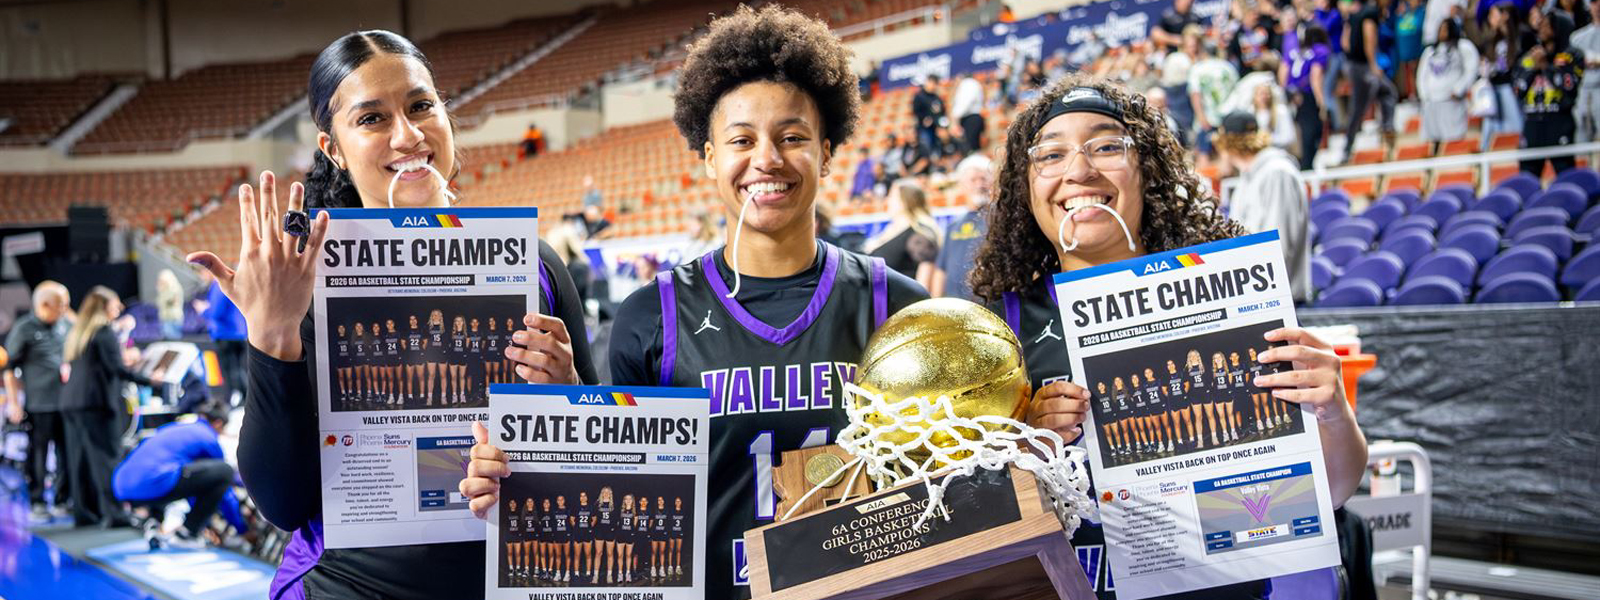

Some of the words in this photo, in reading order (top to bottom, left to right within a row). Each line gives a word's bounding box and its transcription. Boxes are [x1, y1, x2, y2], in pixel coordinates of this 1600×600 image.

[402, 216, 429, 226] AIA
[324, 239, 405, 267] STATE
[411, 237, 526, 266] CHAMPS!
[1143, 260, 1171, 274] AIA
[330, 278, 347, 286] 2026
[348, 277, 358, 286] 6A
[359, 276, 400, 286] BASKETBALL
[400, 276, 421, 285] STATE
[421, 275, 471, 285] CHAMPIONSHIP
[1072, 287, 1153, 328] STATE
[1156, 262, 1277, 310] CHAMPS!
[1238, 304, 1259, 313] MARCH
[1266, 300, 1281, 308] 2026
[1083, 335, 1100, 346] 2026
[1110, 325, 1151, 340] BASKETBALL
[1151, 320, 1172, 333] STATE
[1172, 310, 1222, 329] CHAMPIONSHIP
[387, 342, 397, 350] 24
[410, 338, 420, 346] 22
[455, 339, 463, 347] 13
[1194, 375, 1202, 383] 15
[1217, 376, 1225, 384] 13
[1235, 375, 1243, 383] 14
[701, 361, 859, 418] VALLEY
[1171, 383, 1180, 391] 22
[578, 394, 605, 404] AIA
[1149, 391, 1158, 399] 24
[363, 416, 389, 425] VALLEY
[390, 415, 411, 424] VISTA
[412, 415, 431, 423] BACK
[432, 414, 443, 423] ON
[444, 414, 458, 422] TOP
[459, 413, 477, 422] ONCE
[500, 413, 579, 443] STATE
[586, 415, 699, 446] CHAMPS!
[384, 438, 412, 446] Mercury
[507, 452, 522, 461] 026
[522, 452, 532, 461] 6A
[532, 453, 572, 462] BASKETBALL
[572, 453, 592, 462] STATE
[593, 454, 642, 463] CHAMPIONSHIP
[1135, 464, 1162, 477] VALLEY
[1163, 460, 1184, 472] VISTA
[1185, 457, 1205, 469] BACK
[1205, 455, 1216, 465] ON
[1217, 452, 1232, 463] TOP
[1232, 449, 1253, 460] ONCE
[1253, 445, 1277, 456] AGAIN
[748, 427, 831, 520] 1
[1159, 481, 1176, 489] Suns
[1160, 485, 1188, 494] Mercury
[866, 500, 887, 511] AIA
[580, 515, 588, 523] 22
[602, 511, 610, 520] 15
[832, 523, 848, 536] 6A
[850, 498, 931, 532] CONFERENC
[527, 520, 532, 528] 5
[557, 519, 565, 527] 24
[640, 519, 647, 527] 14
[675, 519, 681, 527] 3
[1366, 512, 1412, 531] ORADE
[1248, 526, 1277, 538] STATE
[822, 531, 862, 551] GIRLS
[849, 522, 930, 556] CHAMPIONS
[863, 538, 921, 564] 2025-2026
